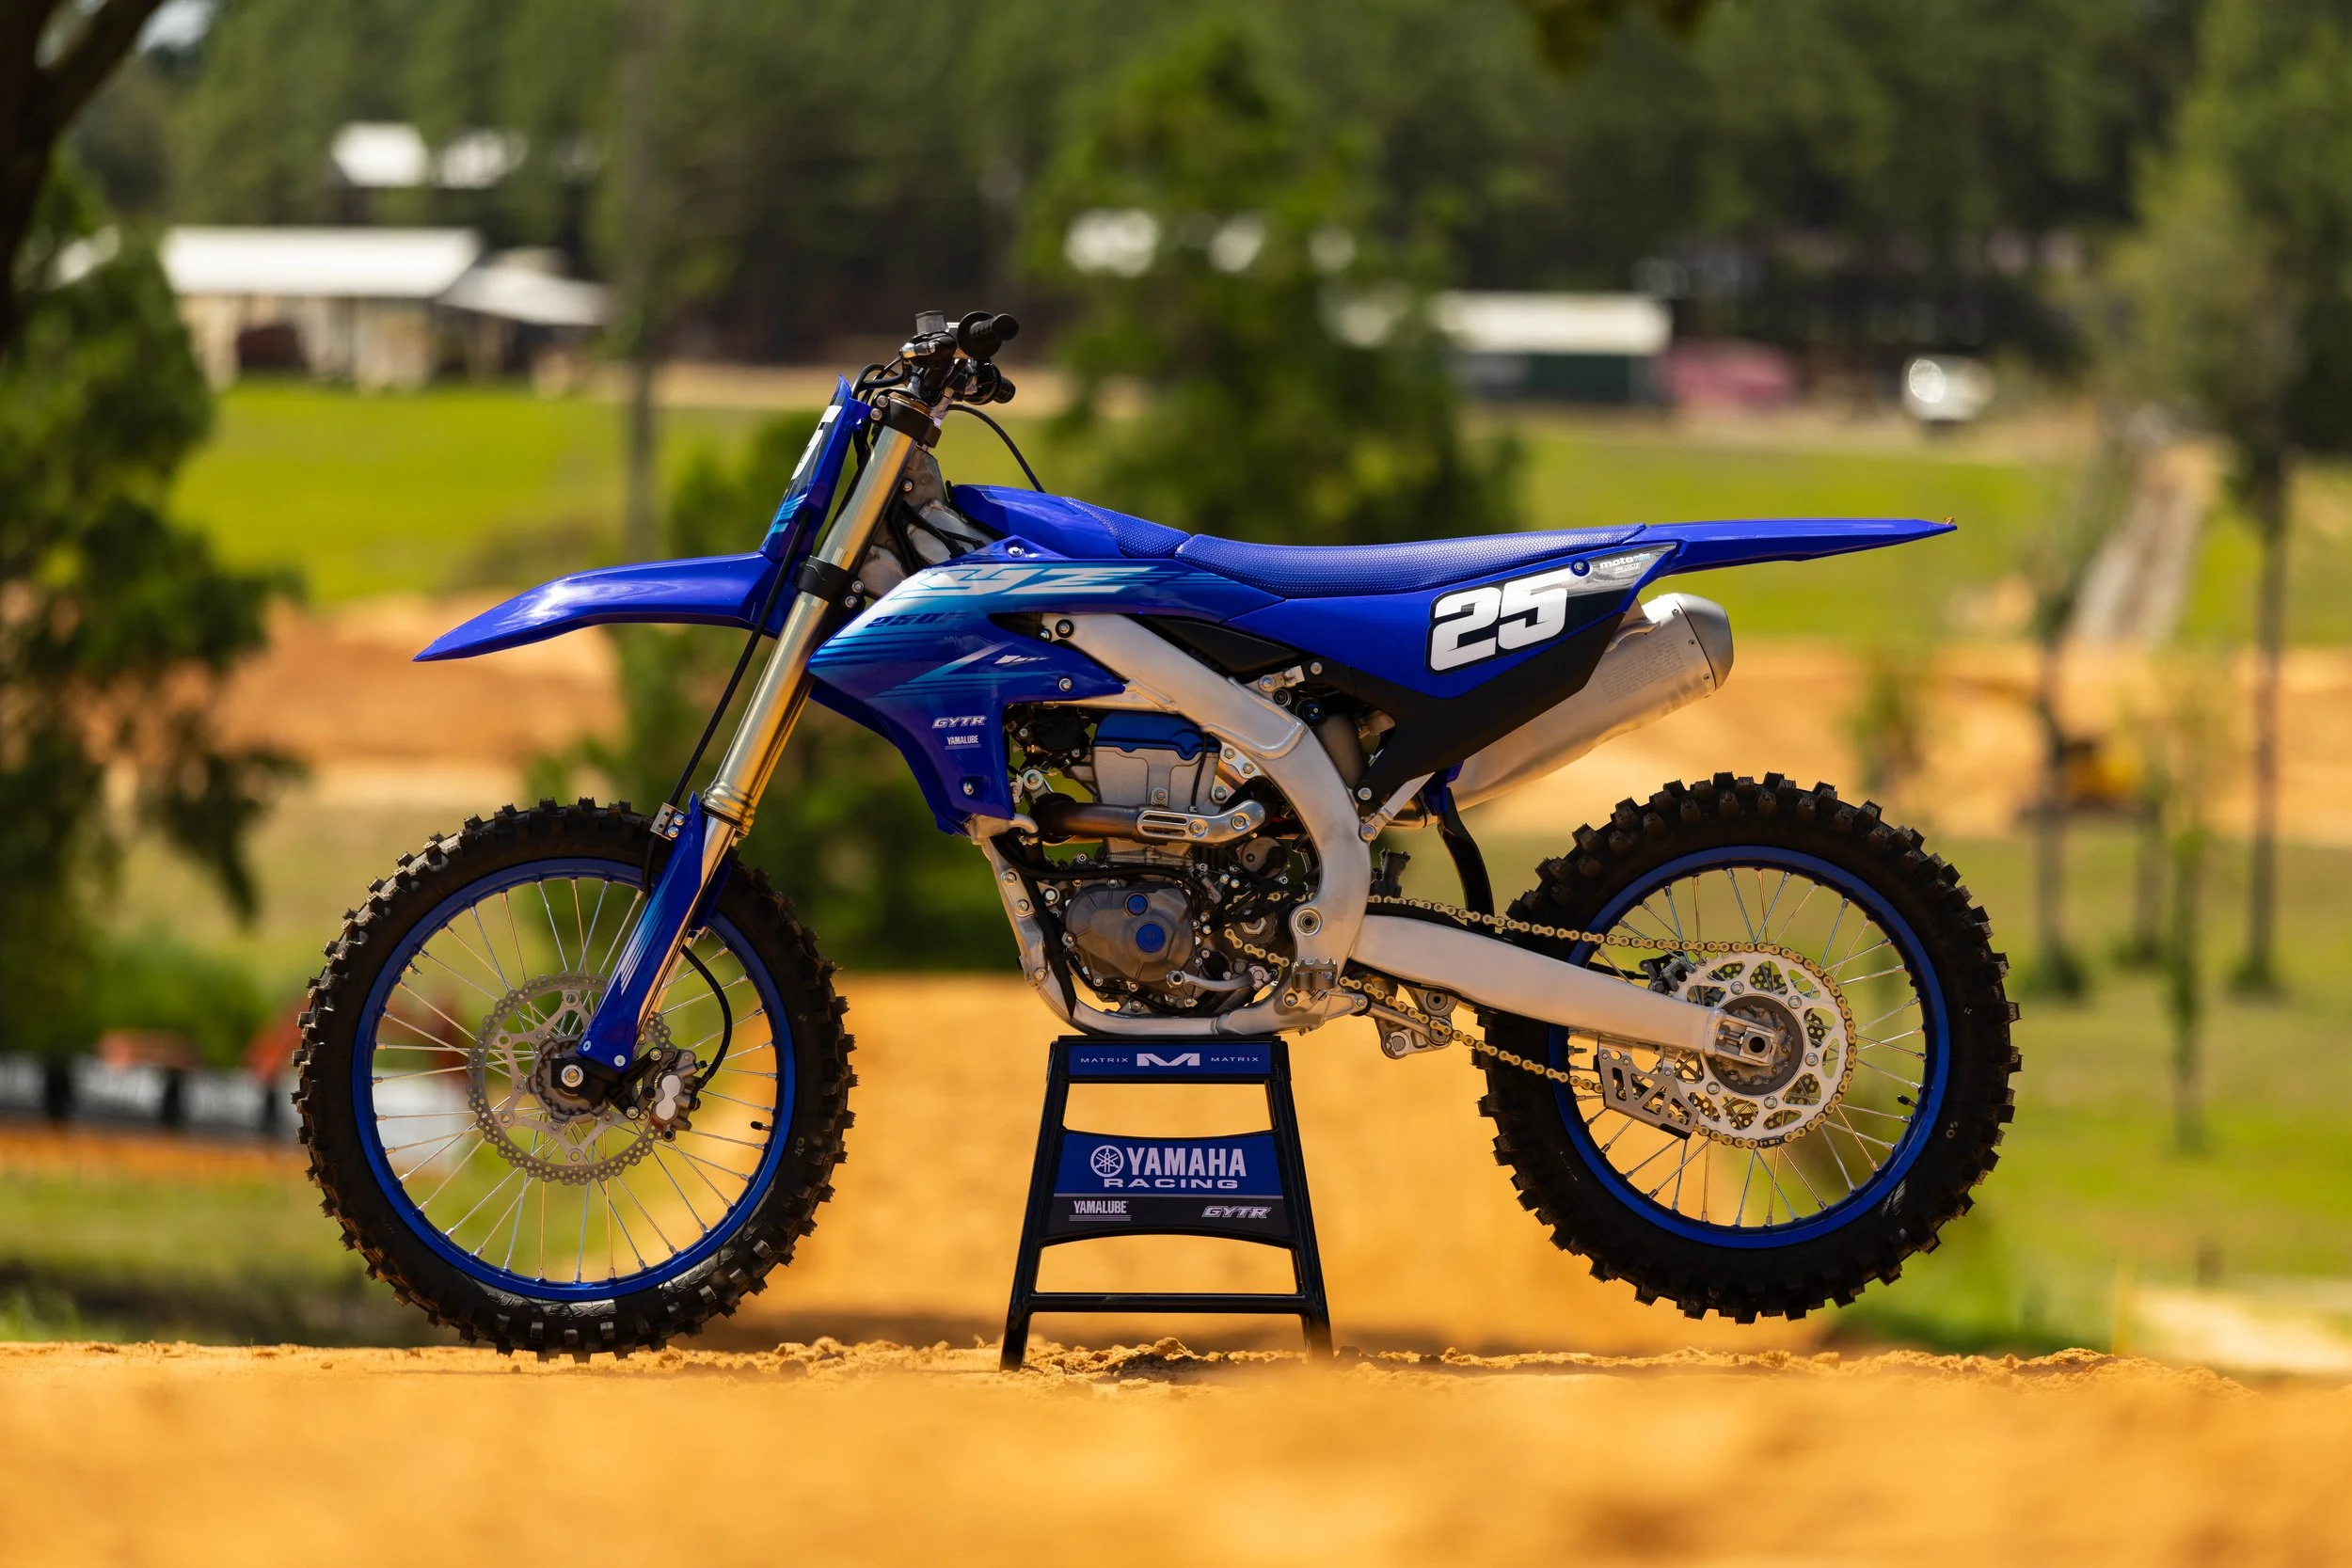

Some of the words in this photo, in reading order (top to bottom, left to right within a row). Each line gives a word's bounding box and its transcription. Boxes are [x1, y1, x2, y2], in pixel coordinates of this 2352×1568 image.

[1429, 568, 1571, 672] 25
[931, 715, 988, 729] GYTR
[946, 735, 979, 745] YAMALUBE
[1126, 1147, 1248, 1177] YAMAHA
[1104, 1178, 1238, 1189] RACING
[1073, 1200, 1128, 1214] YAMALUBE
[1201, 1205, 1271, 1219] GYTR
